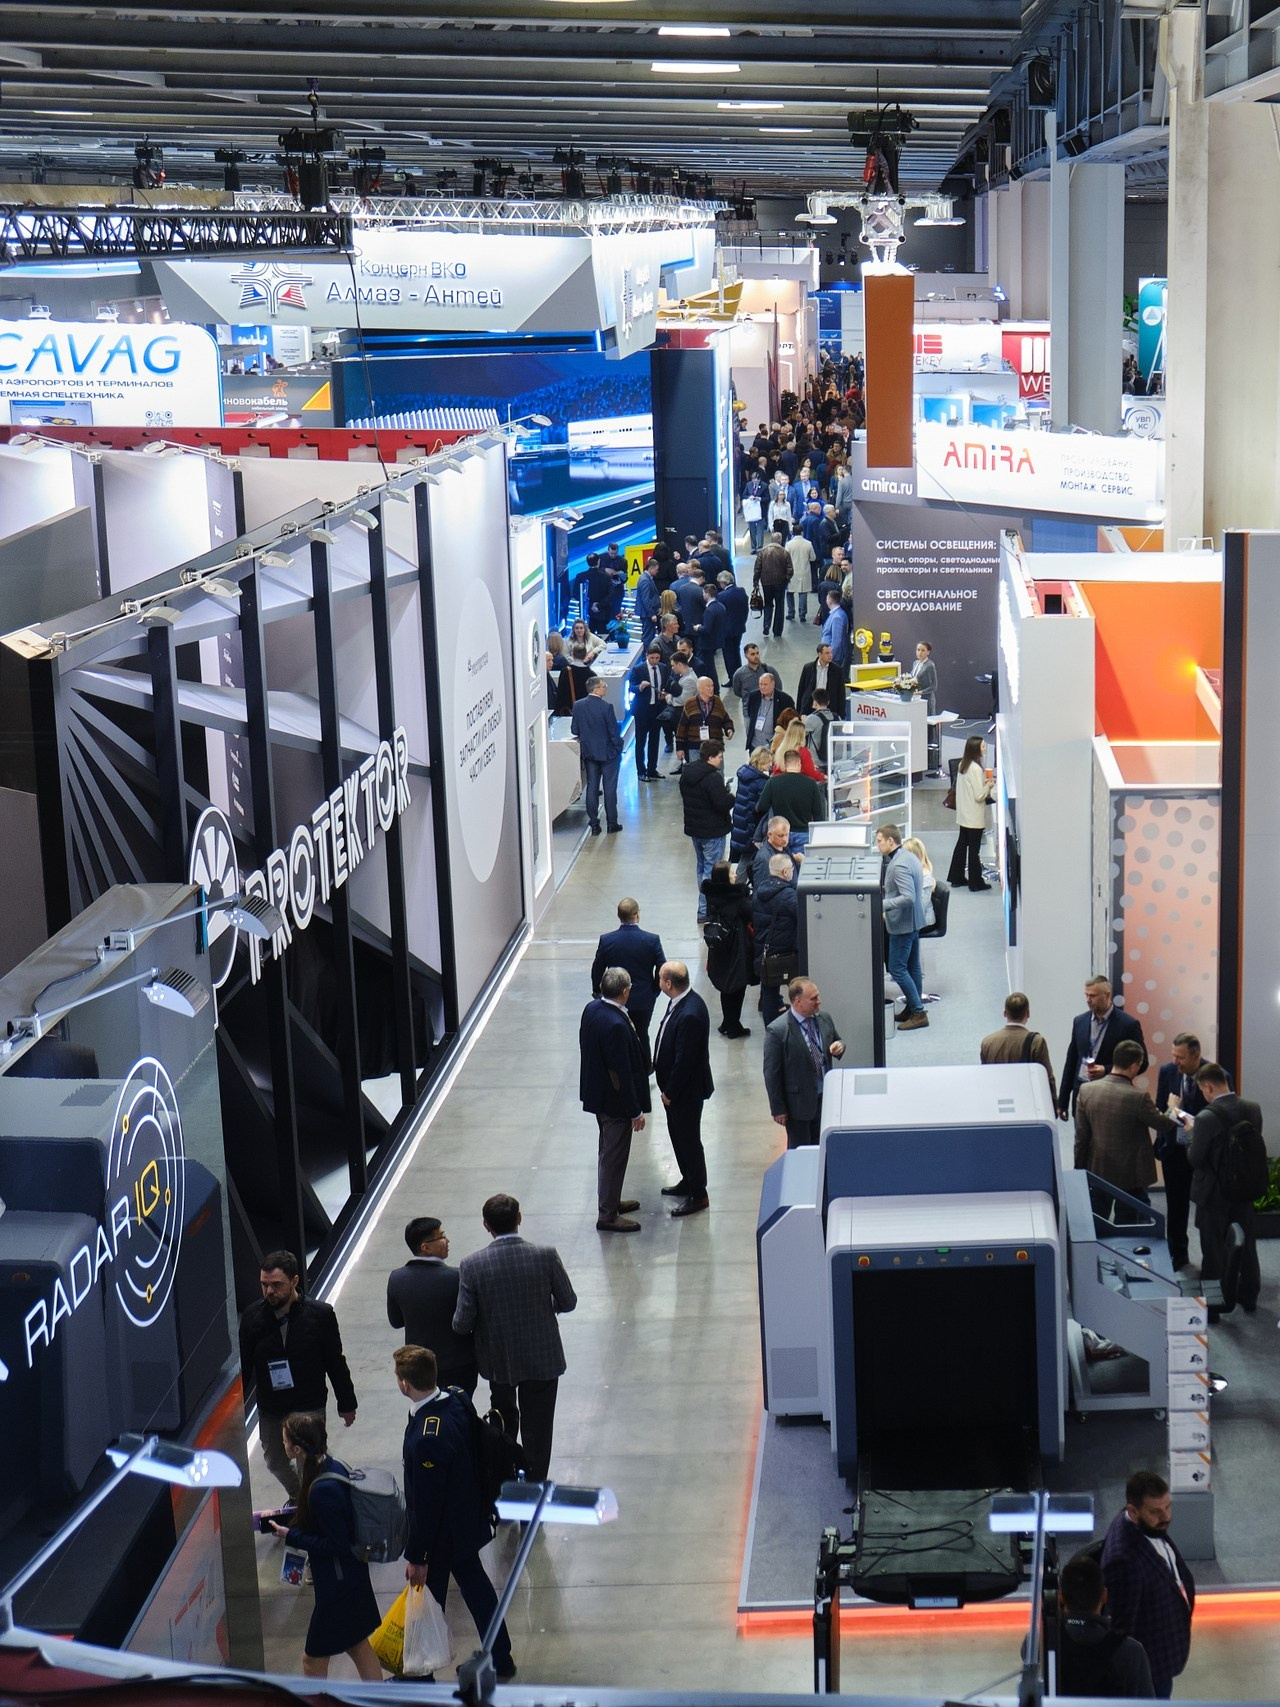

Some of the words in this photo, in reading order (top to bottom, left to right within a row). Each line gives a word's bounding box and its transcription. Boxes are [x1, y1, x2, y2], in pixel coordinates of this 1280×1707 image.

[360, 260, 427, 279] Концерн
[431, 261, 467, 278] ВКО
[326, 281, 401, 303] Алмаз
[424, 284, 504, 305] Антей
[0, 333, 182, 374] CAVAG
[6, 378, 84, 388] АЭРОПОРТОВ
[85, 379, 94, 387] И
[96, 379, 174, 389] ТЕРМИНАЛОВ
[42, 390, 125, 400] СПЕЦТЕХНИКА
[861, 476, 913, 496] amira.ru
[876, 540, 928, 551] СИСТЕМЫ
[929, 540, 997, 552] ОСВЕЩЕНИЯ:
[876, 556, 906, 565] мачты,
[908, 556, 938, 566] опоры,
[876, 566, 931, 575] прожекторы
[932, 566, 939, 574] и
[939, 566, 994, 574] светильники
[877, 589, 978, 600] СВЕТОСИГНАЛЬНОЕ
[877, 601, 962, 613] ОБОРУДОВАНИЕ
[245, 725, 412, 986] PROTEKTOR
[24, 1194, 132, 1369] RADAR
[134, 1159, 160, 1226] IQ
[1067, 1618, 1086, 1626] SONY
